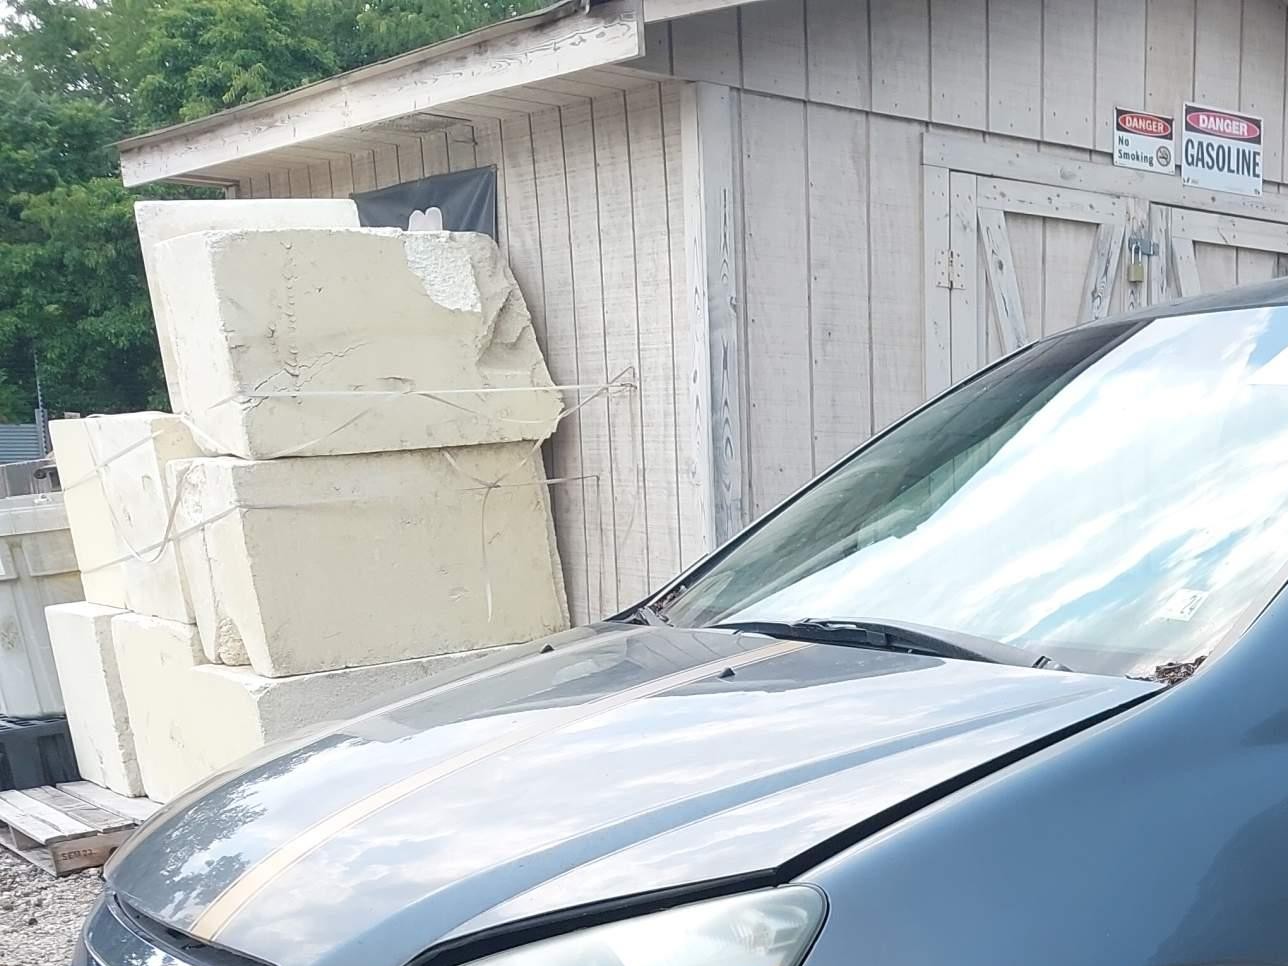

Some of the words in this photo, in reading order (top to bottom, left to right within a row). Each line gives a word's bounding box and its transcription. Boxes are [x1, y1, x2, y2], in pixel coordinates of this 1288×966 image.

[1125, 117, 1165, 134] DANGER
[1199, 114, 1248, 136] DANGER
[1118, 135, 1130, 148] No
[1117, 149, 1154, 167] Smoking
[1184, 138, 1261, 179] GASOLINE
